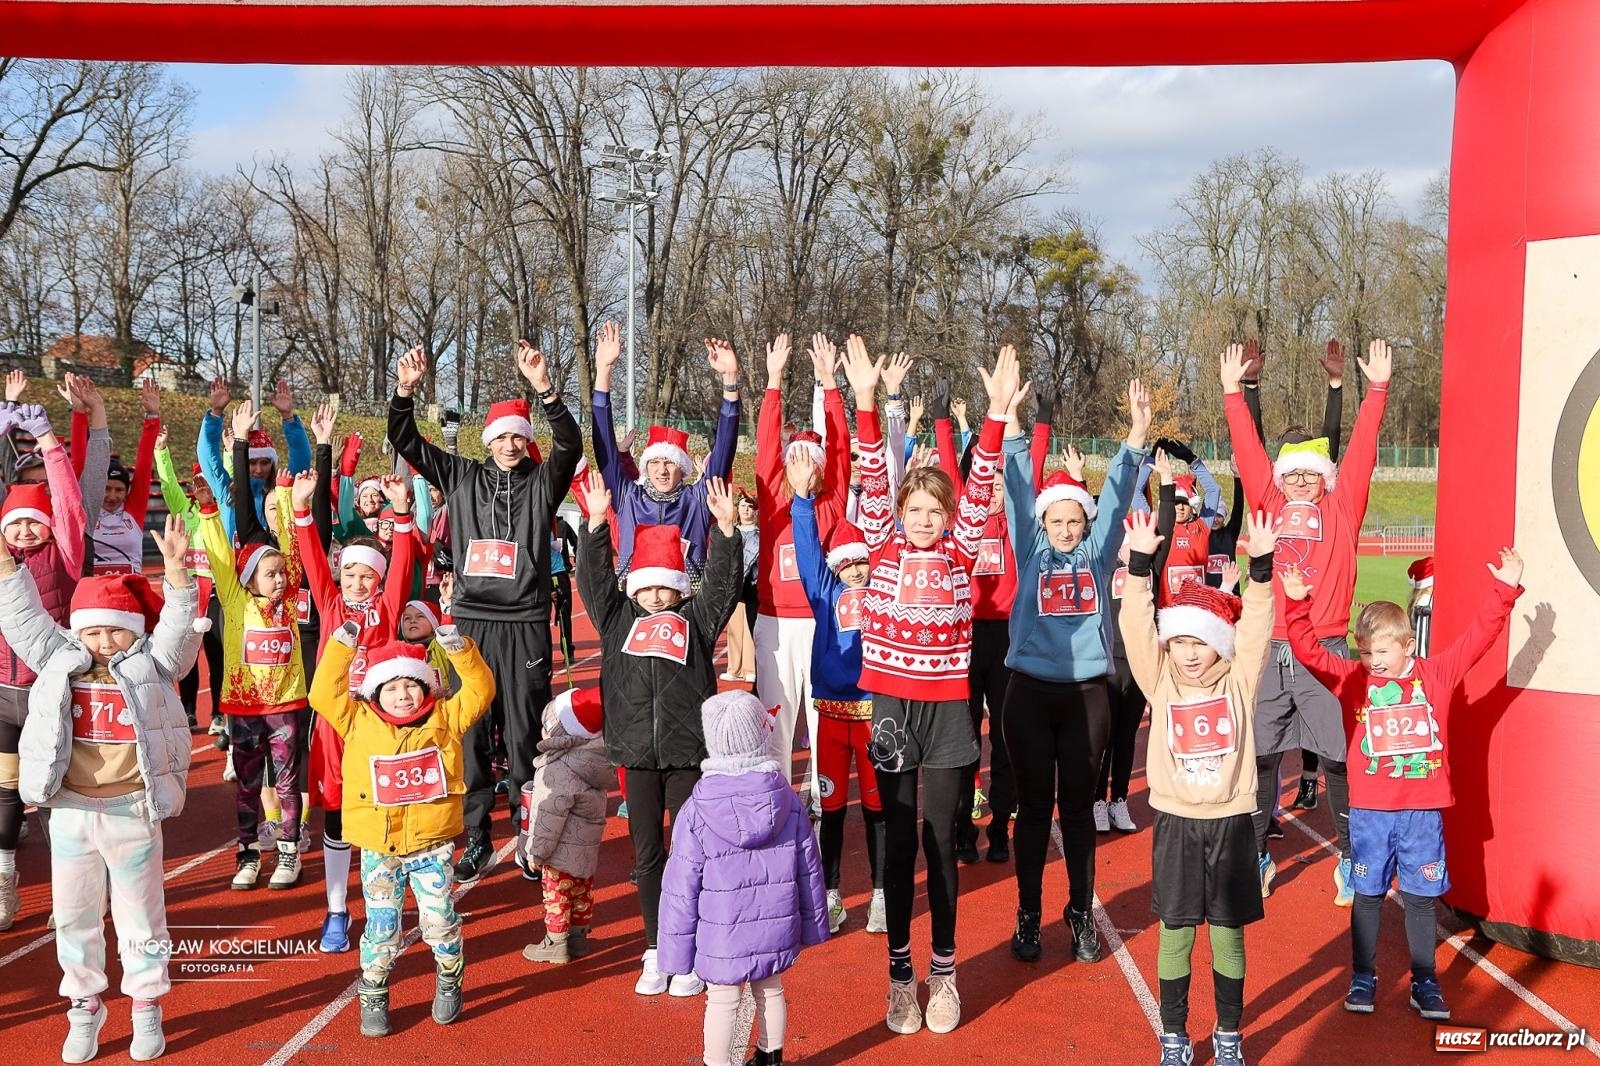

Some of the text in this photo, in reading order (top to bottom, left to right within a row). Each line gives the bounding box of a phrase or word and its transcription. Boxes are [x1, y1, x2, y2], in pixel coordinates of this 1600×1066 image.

[1290, 511, 1302, 526] 5
[193, 553, 208, 564] 90
[482, 549, 500, 563] 14
[1212, 559, 1222, 567] 78
[914, 568, 942, 590] 83
[1057, 583, 1076, 600] 17
[848, 598, 861, 615] 2
[648, 622, 672, 641] 76
[258, 639, 281, 654] 49
[89, 701, 114, 723] 71
[1193, 714, 1211, 737] 6
[1386, 716, 1416, 737] 82
[394, 766, 424, 789] 33
